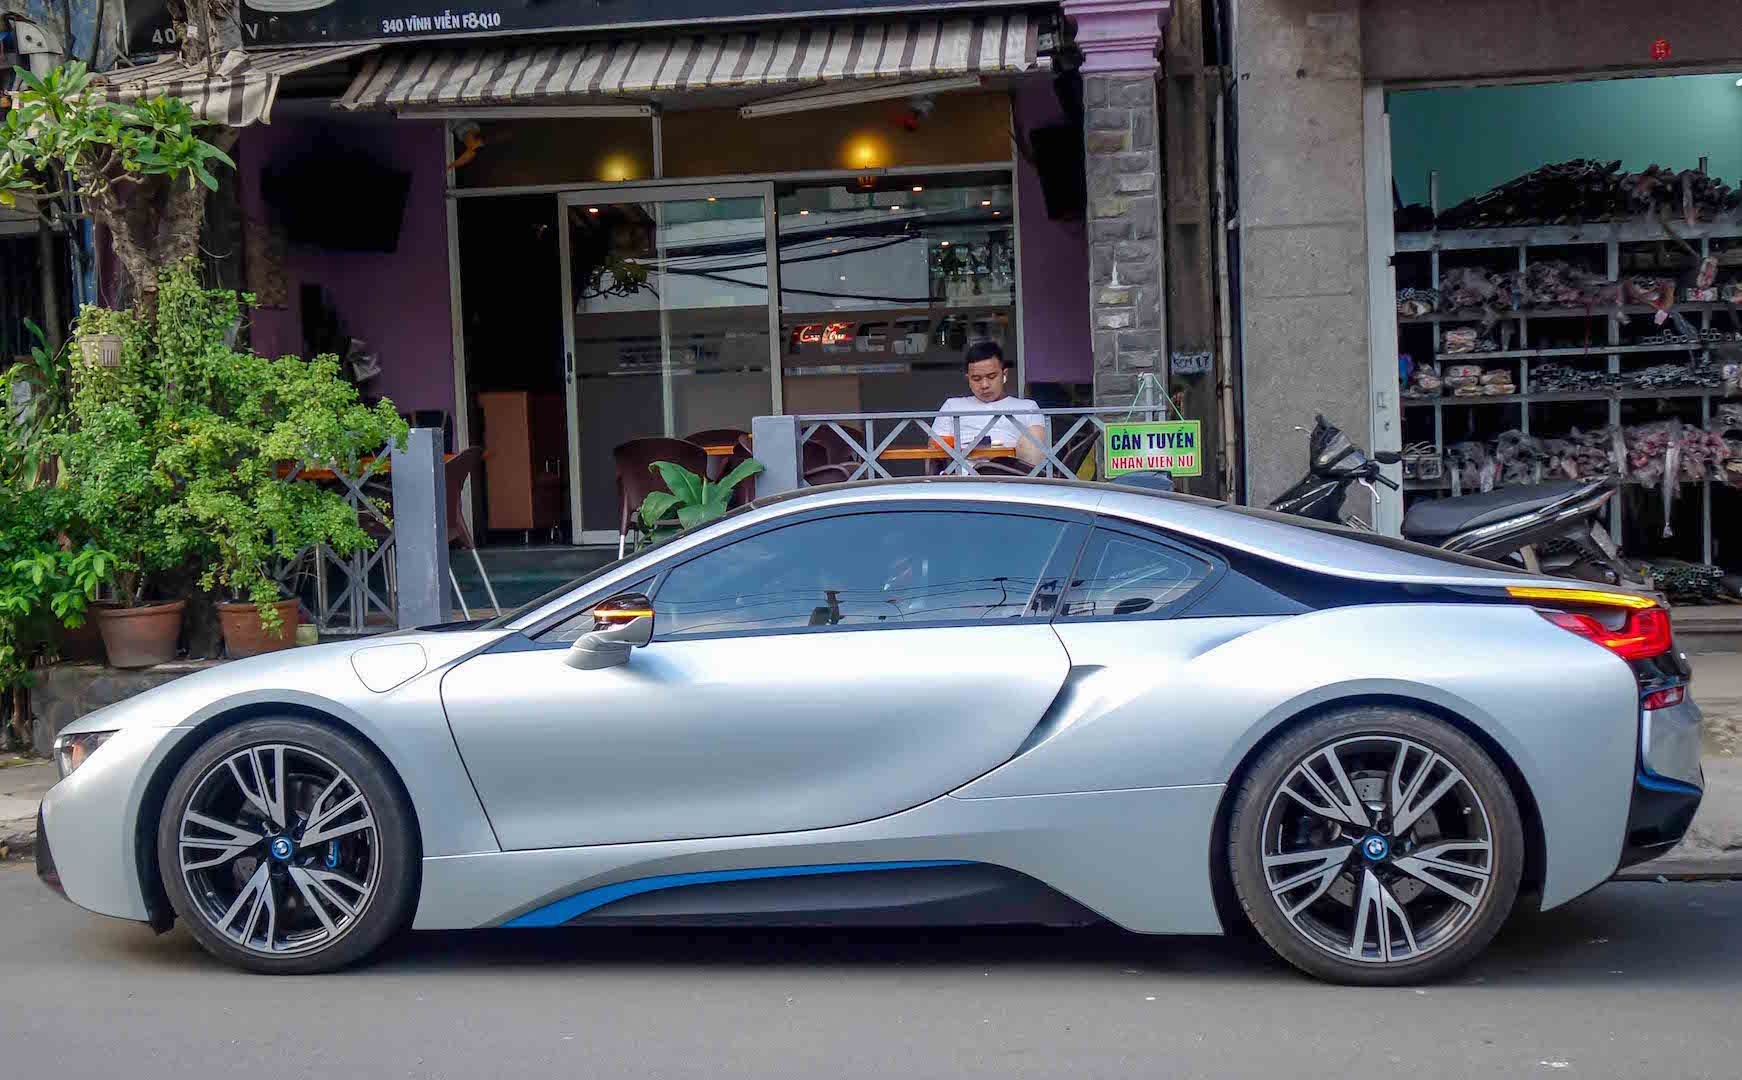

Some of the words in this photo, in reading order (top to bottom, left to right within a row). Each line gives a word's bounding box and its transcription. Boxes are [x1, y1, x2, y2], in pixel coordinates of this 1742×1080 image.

[382, 19, 404, 33] 340
[405, 14, 432, 31] VĨNH
[433, 9, 460, 30] VIỄN
[1111, 428, 1142, 451] CẦN
[1146, 426, 1194, 449] TUYỂN
